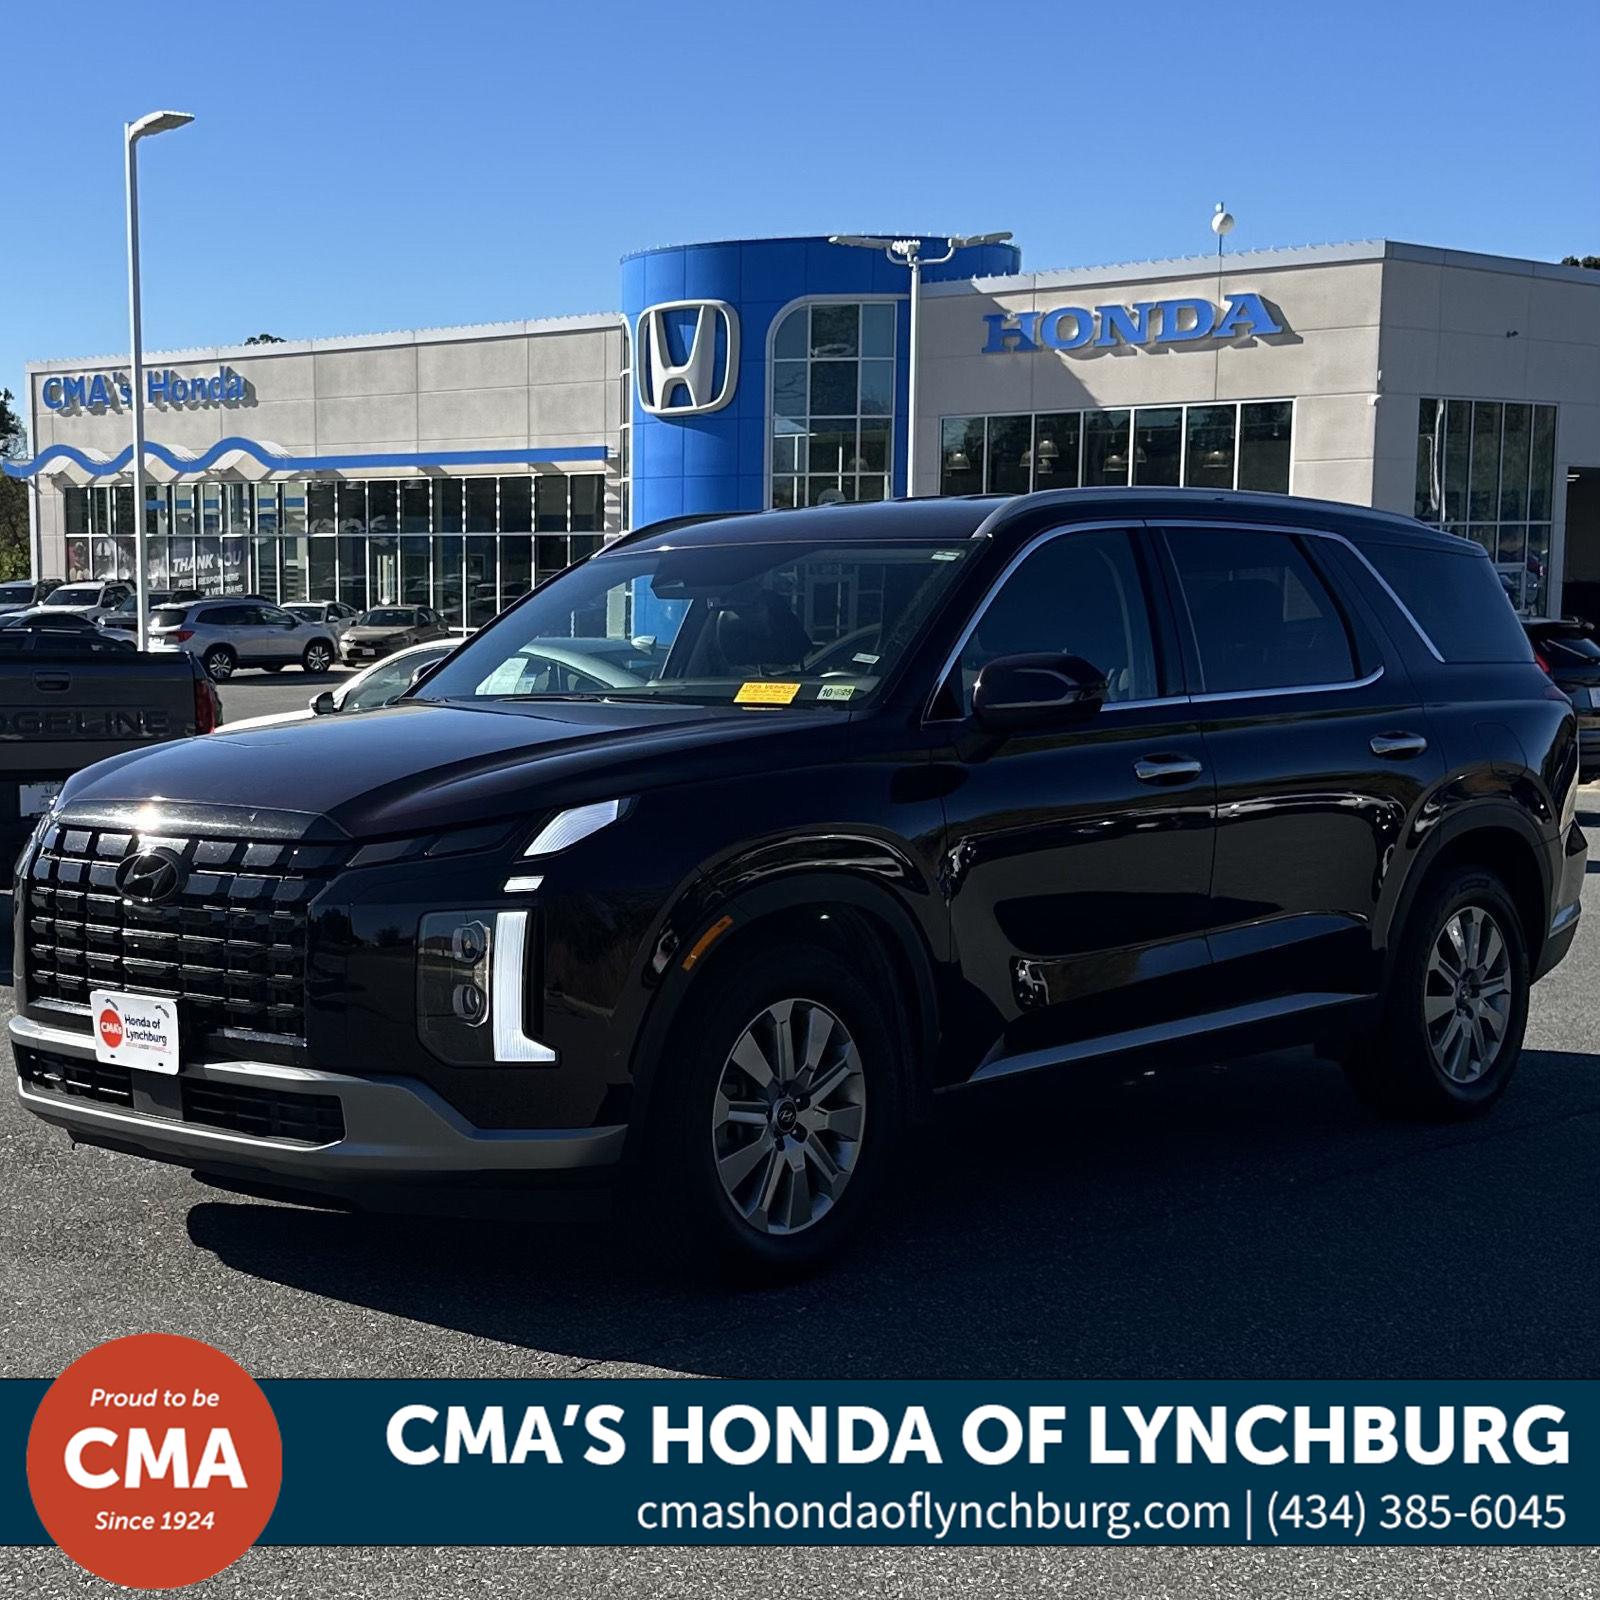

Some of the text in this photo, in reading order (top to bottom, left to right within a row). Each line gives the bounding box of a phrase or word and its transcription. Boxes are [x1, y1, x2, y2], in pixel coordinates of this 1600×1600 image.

[982, 293, 1282, 354] HONDA
[42, 366, 246, 410] CMA's Honda
[172, 553, 214, 573] THANK
[211, 584, 243, 596] VETRANS
[124, 1014, 161, 1030] Honda of
[125, 1028, 168, 1047] Lynchburg
